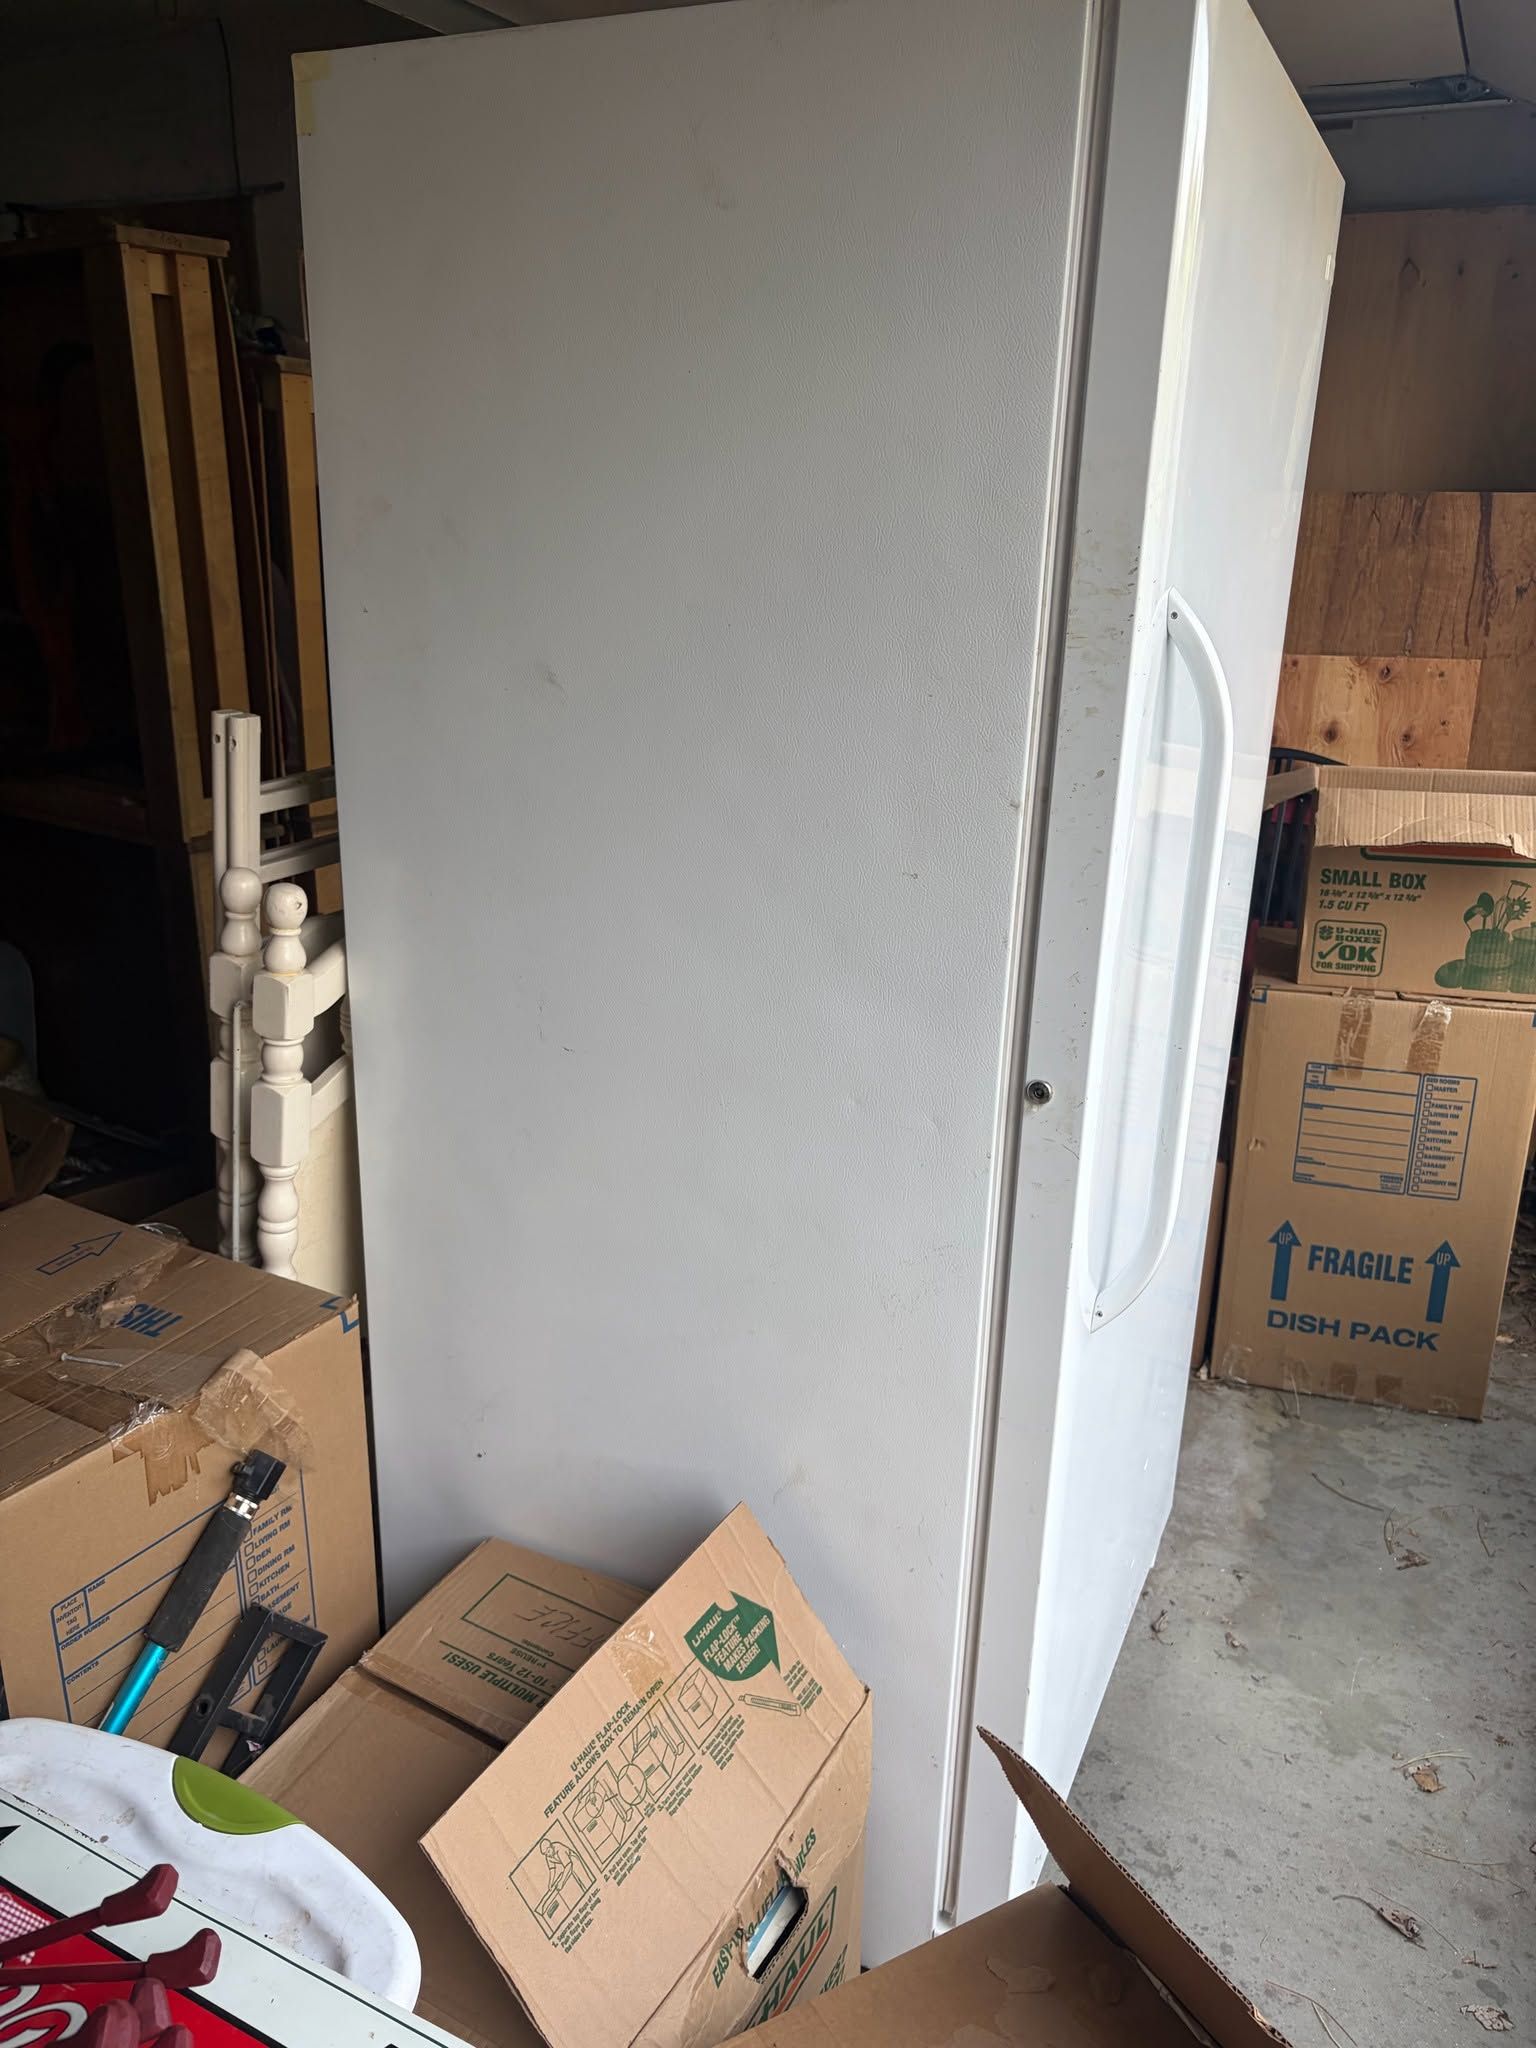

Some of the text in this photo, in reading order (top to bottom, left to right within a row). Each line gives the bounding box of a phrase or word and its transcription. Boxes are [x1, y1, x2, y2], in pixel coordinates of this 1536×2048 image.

[1320, 868, 1427, 890] SMALL BOX
[1319, 900, 1369, 912] 1.5 CU FT
[1335, 934, 1381, 944] BOXES
[1338, 945, 1377, 963] OK
[1316, 961, 1376, 973] FOR SHIPPING
[1425, 1136, 1452, 1144] KITCHEN
[1278, 1231, 1292, 1245] UP
[1308, 1244, 1414, 1285] FRAGILE
[1436, 1252, 1451, 1266] UP
[1267, 1310, 1440, 1352] DISH PACK
[253, 1505, 292, 1535] FAMILY RM
[254, 1520, 291, 1549] LIVING RM
[256, 1547, 271, 1562] DEN
[257, 1544, 295, 1576] DINING RM
[259, 1562, 290, 1588] KITCHEN
[60, 1597, 78, 1611] PLACE
[260, 1583, 280, 1601] BATH
[56, 1602, 84, 1624] INVENTORY
[66, 1616, 77, 1626] TAG
[61, 1616, 110, 1650] ORDER NUMBER
[723, 1615, 771, 1672] MAKES PACKING
[713, 1631, 743, 1667] FEATURE
[736, 1642, 761, 1674] EASIER!
[66, 1661, 99, 1685] CONTENTS
[441, 1651, 538, 1703] MULTIPLE USES!
[486, 1652, 549, 1687] 10-12 Years
[596, 1701, 632, 1740] FLAP-LOCK
[544, 1678, 664, 1818] FEATURE ALLOWS BOX TO REMAIN OPEN
